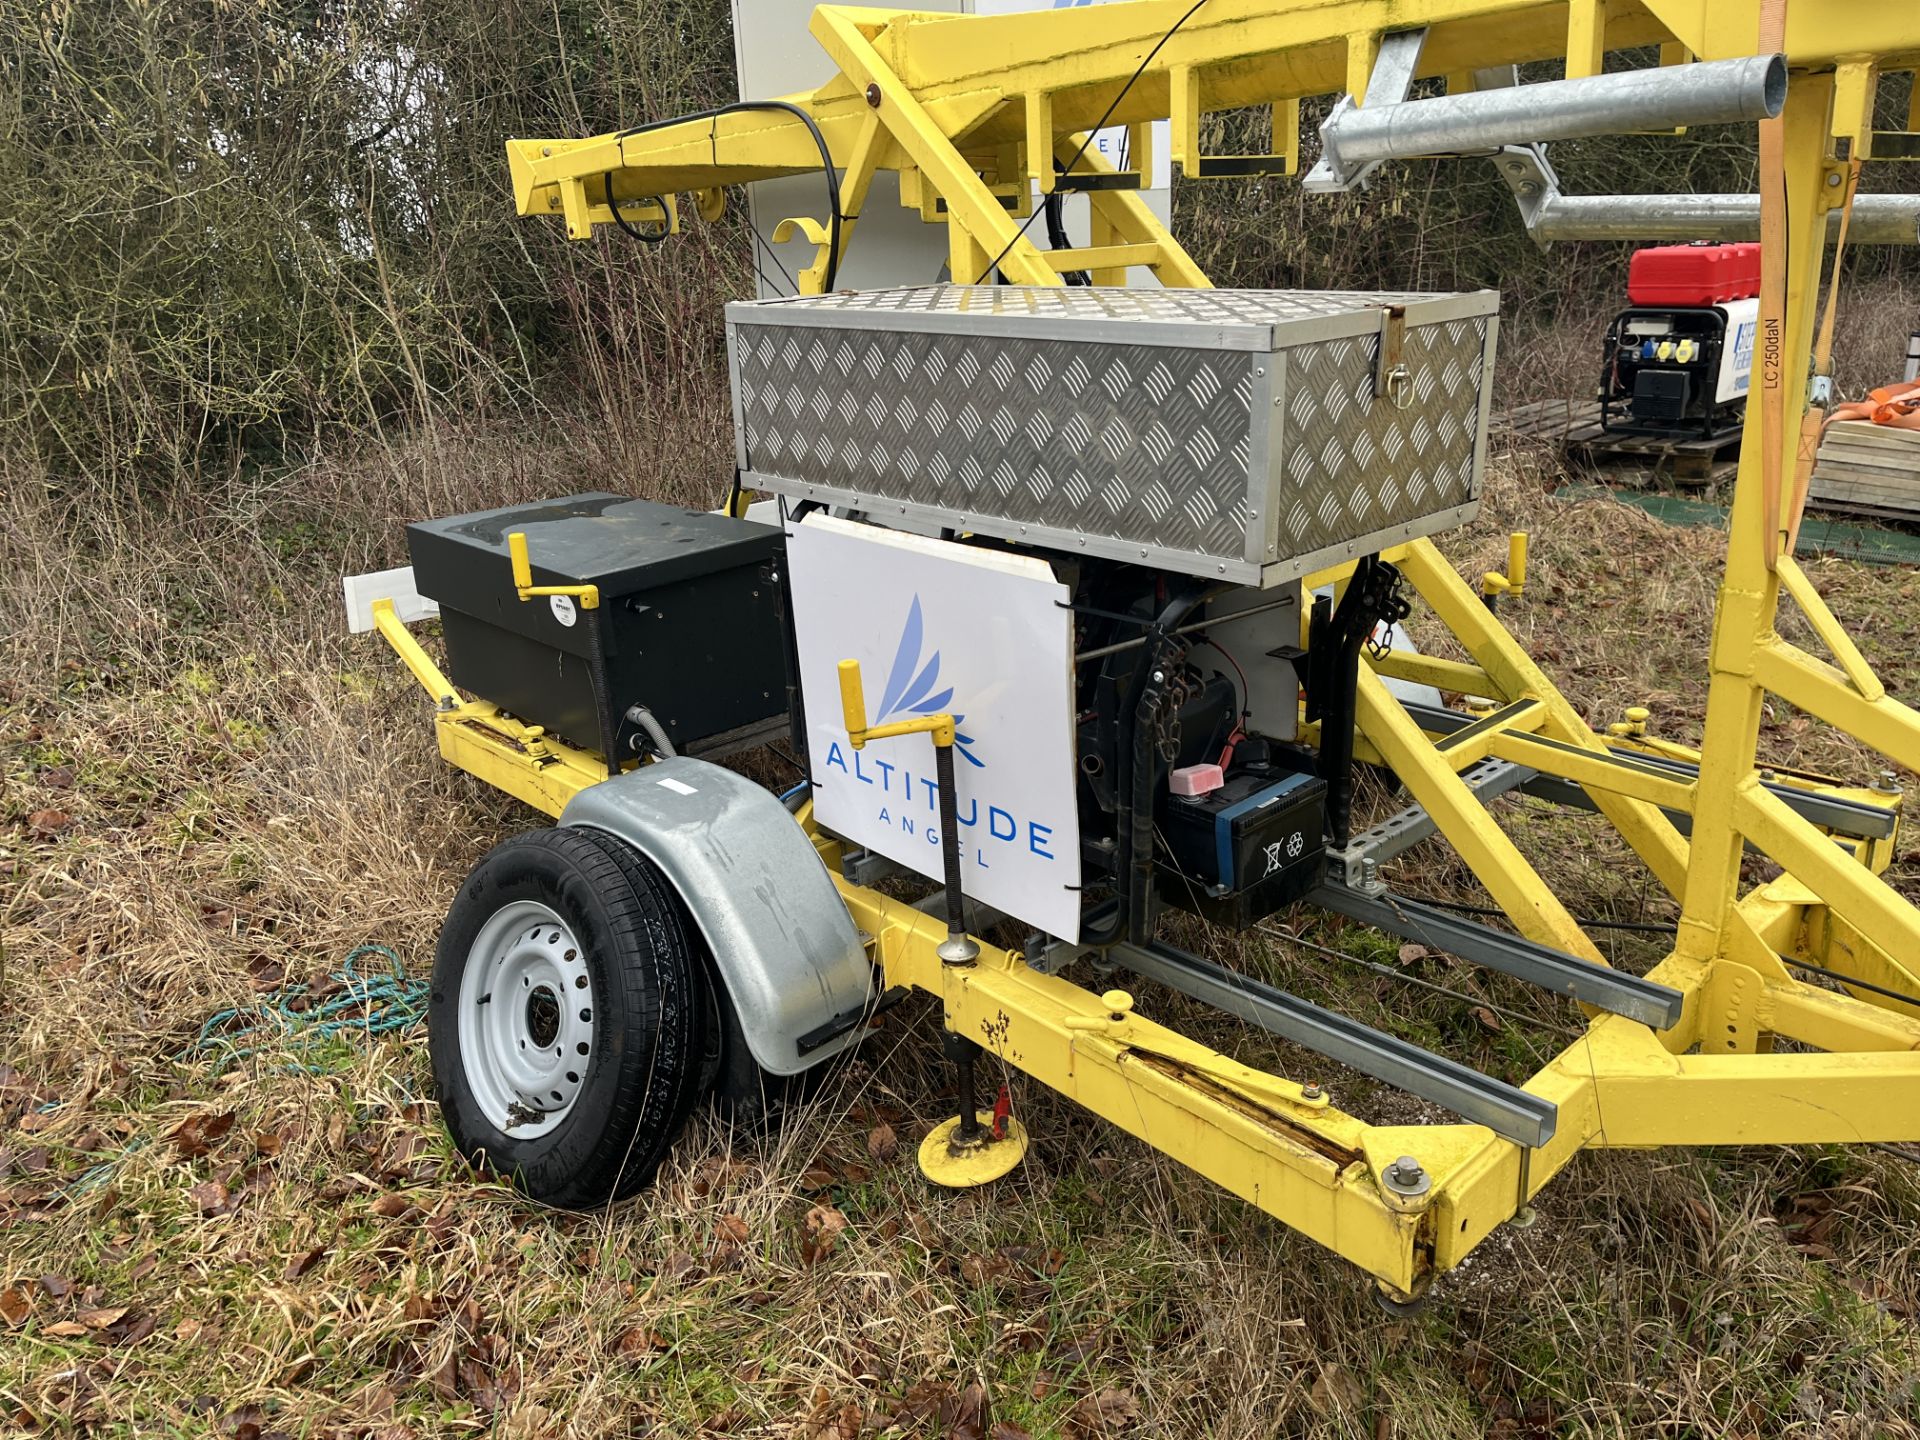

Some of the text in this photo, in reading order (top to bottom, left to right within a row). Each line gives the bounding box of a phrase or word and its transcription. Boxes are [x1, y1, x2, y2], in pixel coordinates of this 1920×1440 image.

[1764, 319, 1779, 389] LC 250daN
[826, 742, 1055, 860] ALTITUDE
